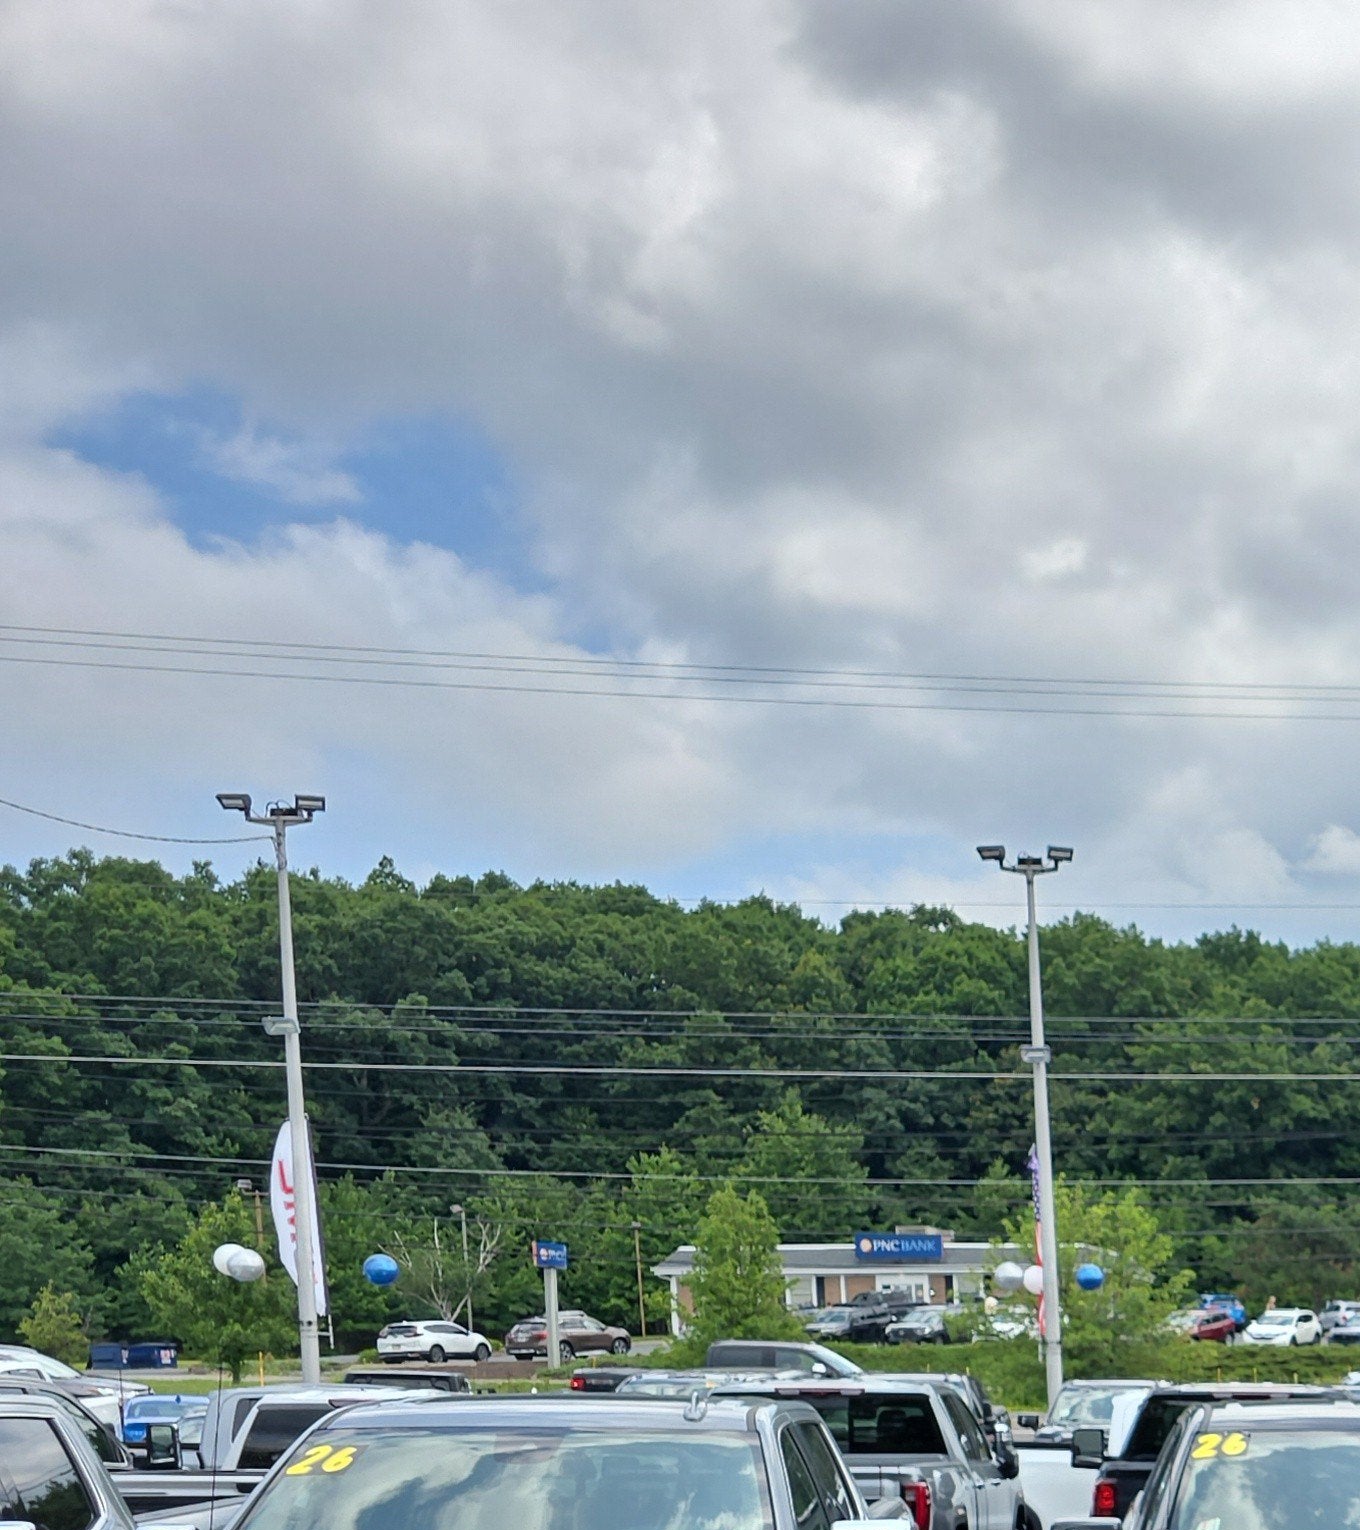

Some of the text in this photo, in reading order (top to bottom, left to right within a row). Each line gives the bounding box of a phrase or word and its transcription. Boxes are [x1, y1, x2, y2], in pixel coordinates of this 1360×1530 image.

[873, 1239, 936, 1252] PNC BANK
[1191, 1432, 1247, 1459] 26
[286, 1444, 358, 1475] 26
